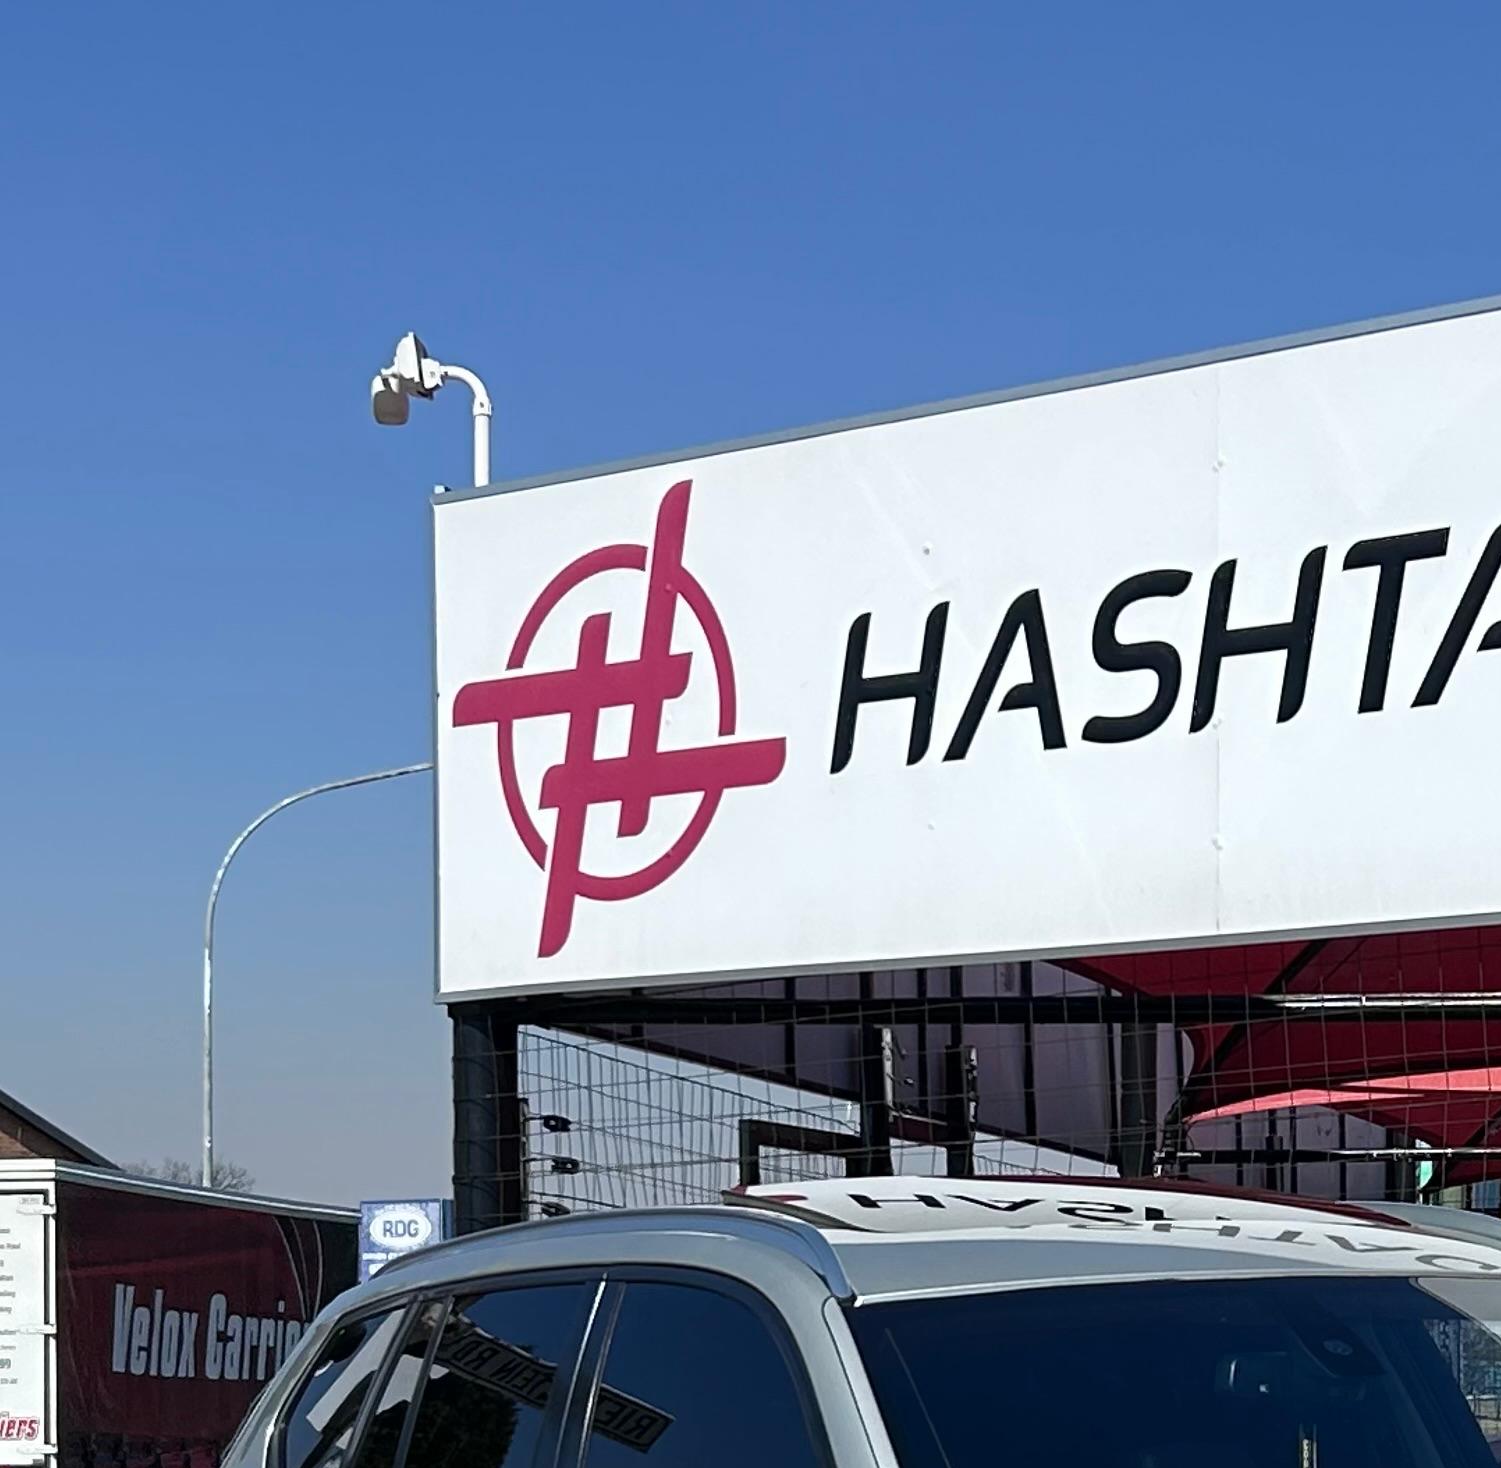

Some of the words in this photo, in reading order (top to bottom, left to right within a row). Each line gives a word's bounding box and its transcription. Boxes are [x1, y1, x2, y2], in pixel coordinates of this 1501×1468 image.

[382, 1219, 420, 1239] RDG
[112, 1283, 199, 1379] Velox
[205, 1293, 311, 1381] Carrie
